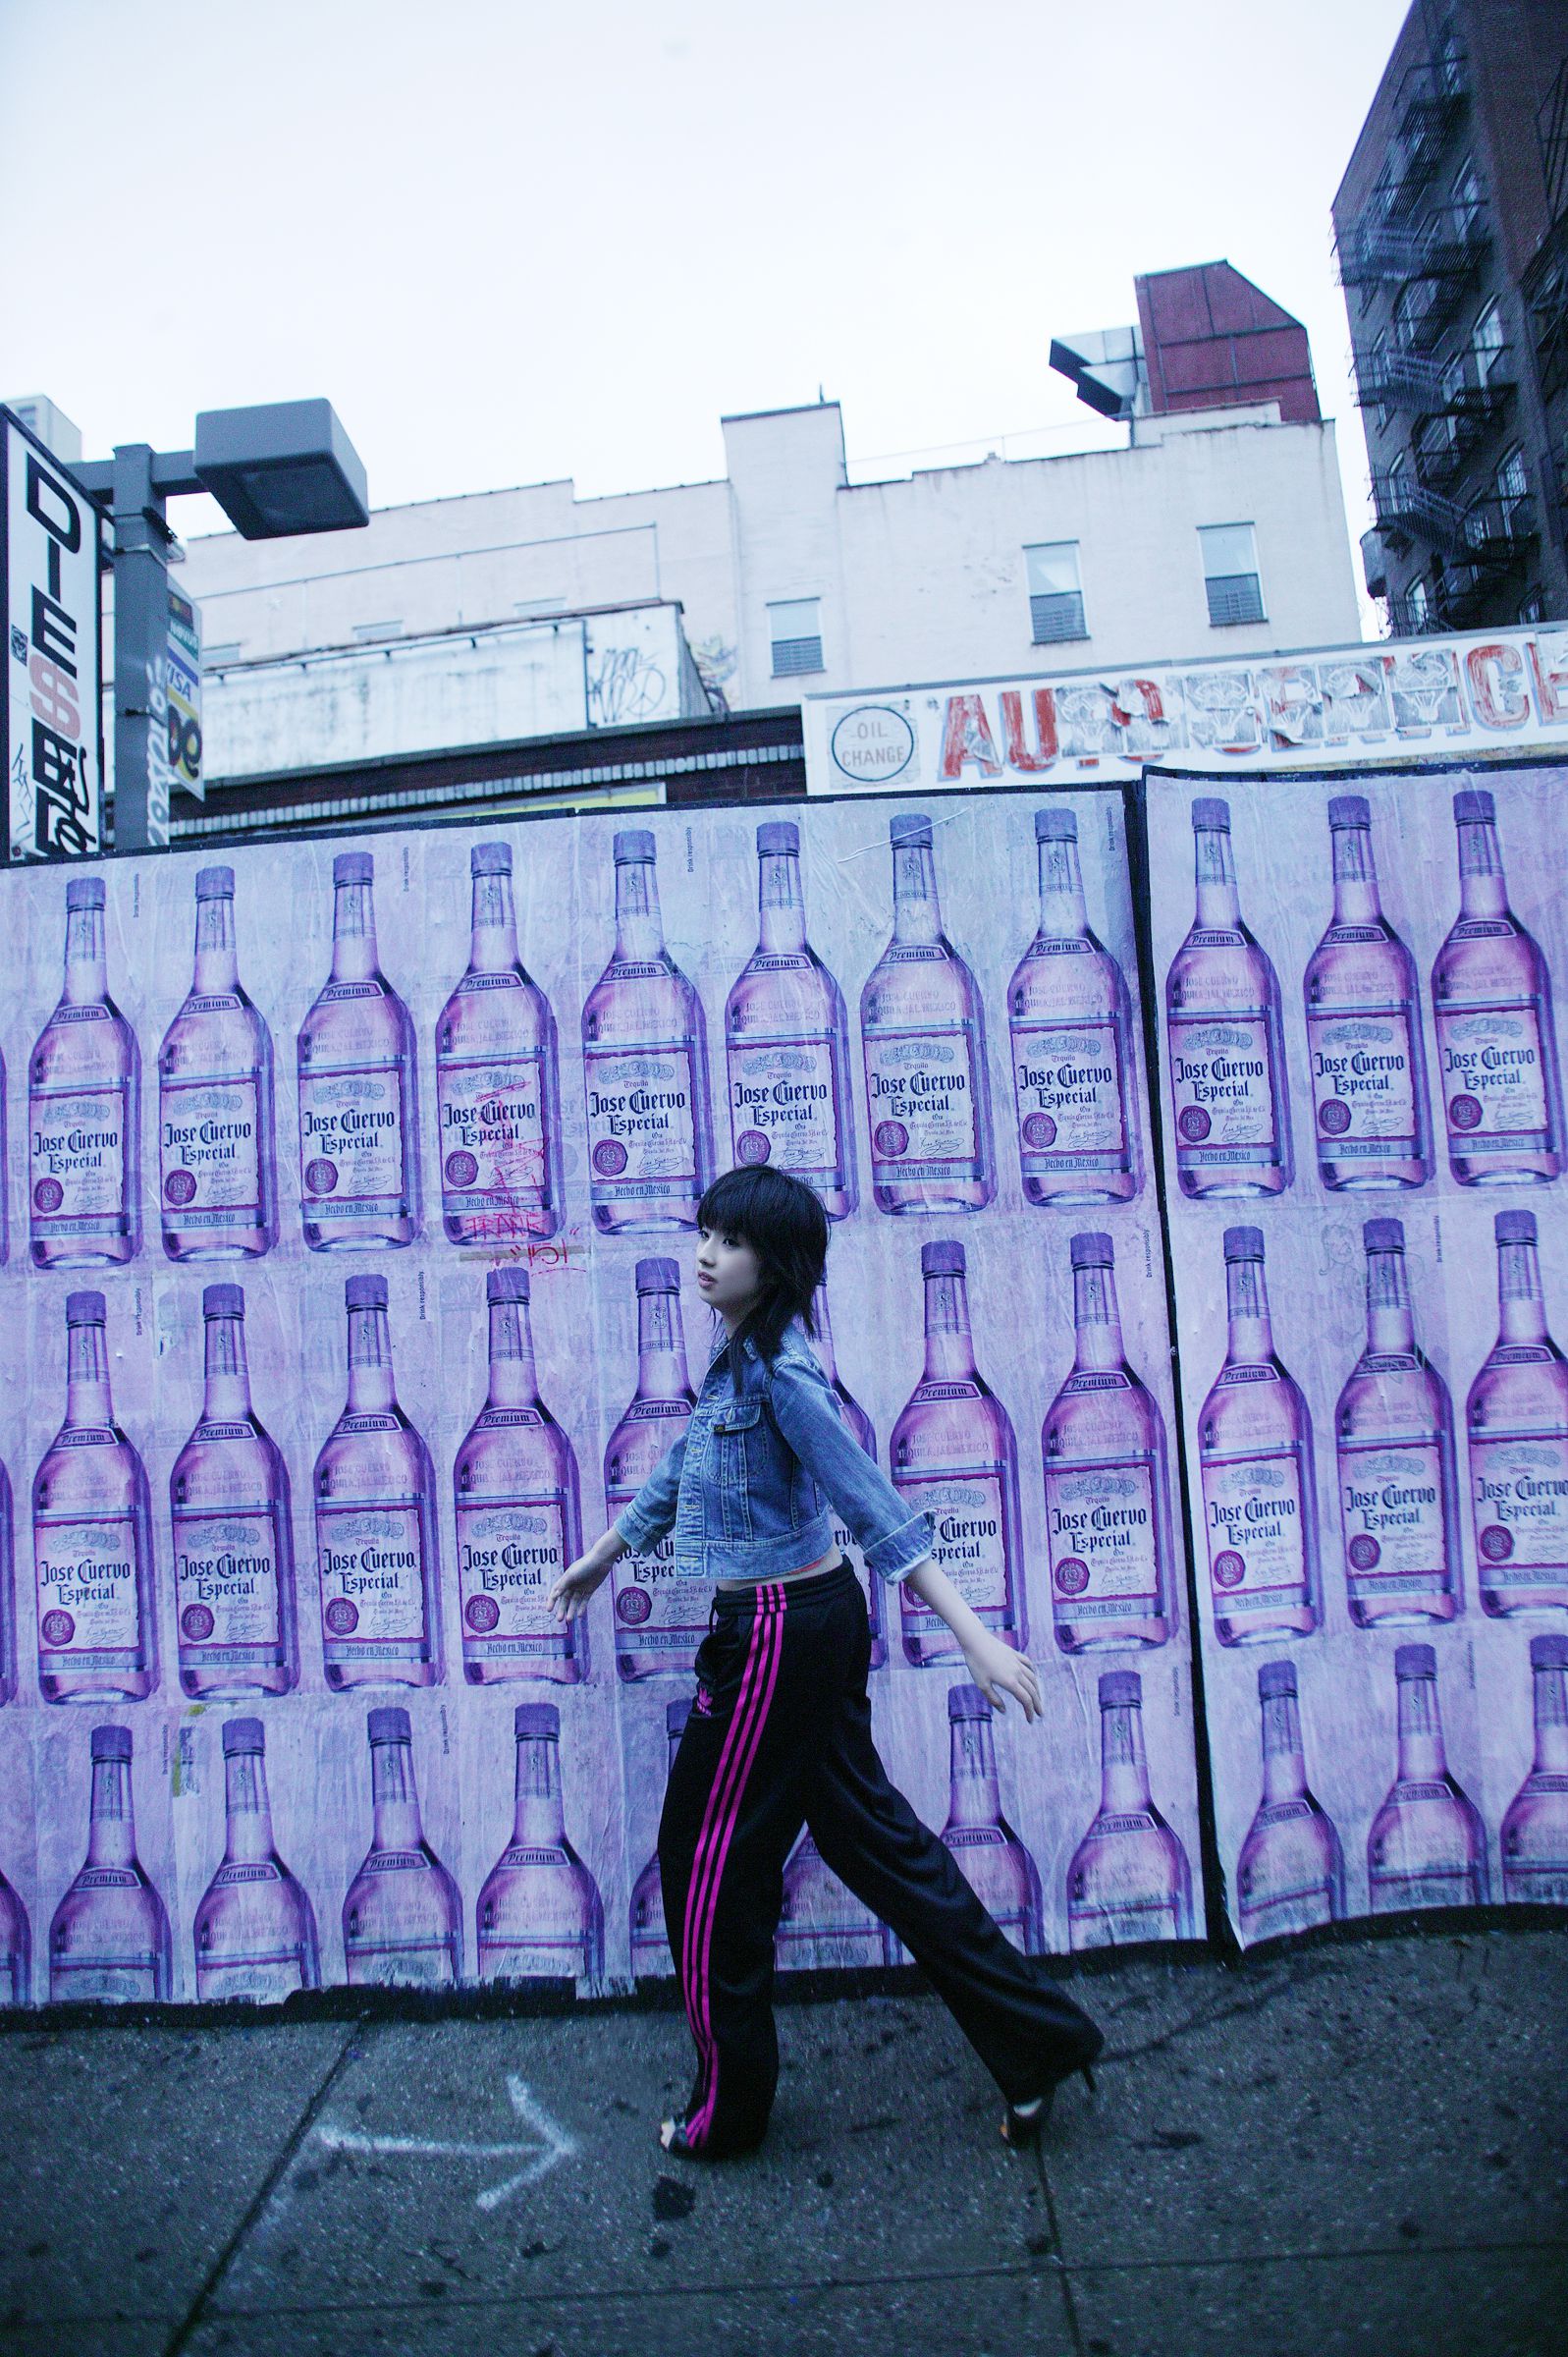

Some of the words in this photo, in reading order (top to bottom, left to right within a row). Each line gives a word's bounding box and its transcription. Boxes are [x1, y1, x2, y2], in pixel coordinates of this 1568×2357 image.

[857, 723, 888, 740] OIL
[842, 746, 904, 767] CHANGE
[1192, 935, 1234, 945] Premium
[1329, 931, 1375, 941] Premium
[890, 950, 936, 960] Premium
[1036, 943, 1081, 954] Premium
[610, 966, 658, 978] Premium
[754, 959, 800, 969] Premium
[326, 986, 371, 999] Premium
[465, 977, 511, 989] Premium
[1174, 1058, 1209, 1083] Jose
[1212, 1057, 1264, 1081] Cuervo
[1314, 1052, 1348, 1077] Jose
[1351, 1051, 1405, 1075] Cuervo
[1443, 1048, 1479, 1073] Jose
[1482, 1045, 1536, 1069] Cuervo
[870, 1072, 906, 1099] Jose
[909, 1070, 966, 1096] Cuervo
[1018, 1065, 1054, 1091] Jose
[1057, 1064, 1112, 1088] Cuervo
[1329, 1073, 1390, 1095] Especial
[1460, 1068, 1521, 1090] Especial
[732, 1082, 770, 1108] Jose
[773, 1080, 829, 1106] Cuervo
[1035, 1086, 1097, 1109] Especial
[1190, 1079, 1250, 1102] Especial
[442, 1103, 478, 1128] Jose
[481, 1100, 536, 1125] Cuervo
[589, 1091, 626, 1118] Jose
[629, 1089, 686, 1115] Cuervo
[749, 1104, 813, 1125] Especial
[887, 1094, 950, 1117] Especial
[163, 1123, 197, 1148] Jose
[199, 1120, 252, 1144] Cuervo
[302, 1111, 338, 1137] Jose
[341, 1109, 396, 1133] Cuervo
[606, 1112, 670, 1135] Especial
[32, 1131, 66, 1157] Jose
[68, 1128, 119, 1153] Cuervo
[178, 1142, 236, 1165] Especial
[318, 1130, 379, 1154] Especial
[46, 1151, 103, 1174] Especial
[920, 1387, 968, 1398] Premium
[1071, 1377, 1117, 1389] Premium
[483, 1413, 530, 1425] Premium
[633, 1404, 681, 1417] Premium
[198, 1427, 243, 1439] Premium
[343, 1419, 389, 1431] Premium
[61, 1434, 105, 1445] Premium
[940, 1516, 997, 1543] Cuervo
[1052, 1508, 1088, 1535] Jose
[1091, 1506, 1148, 1531] Cuervo
[931, 1540, 980, 1564] special
[1067, 1528, 1131, 1553] Especial
[179, 1555, 214, 1581] Jose
[217, 1553, 271, 1579] Cuervo
[322, 1548, 357, 1575] Jose
[360, 1547, 415, 1573] Cuervo
[461, 1545, 499, 1571] Jose
[502, 1543, 558, 1569] Cuervo
[39, 1561, 75, 1587] Jose
[78, 1559, 131, 1584] Cuervo
[338, 1571, 400, 1594] Especial
[478, 1567, 542, 1591] Especial
[629, 1561, 675, 1583] Espec
[55, 1582, 115, 1606] Especial
[194, 1577, 255, 1600] Especial
